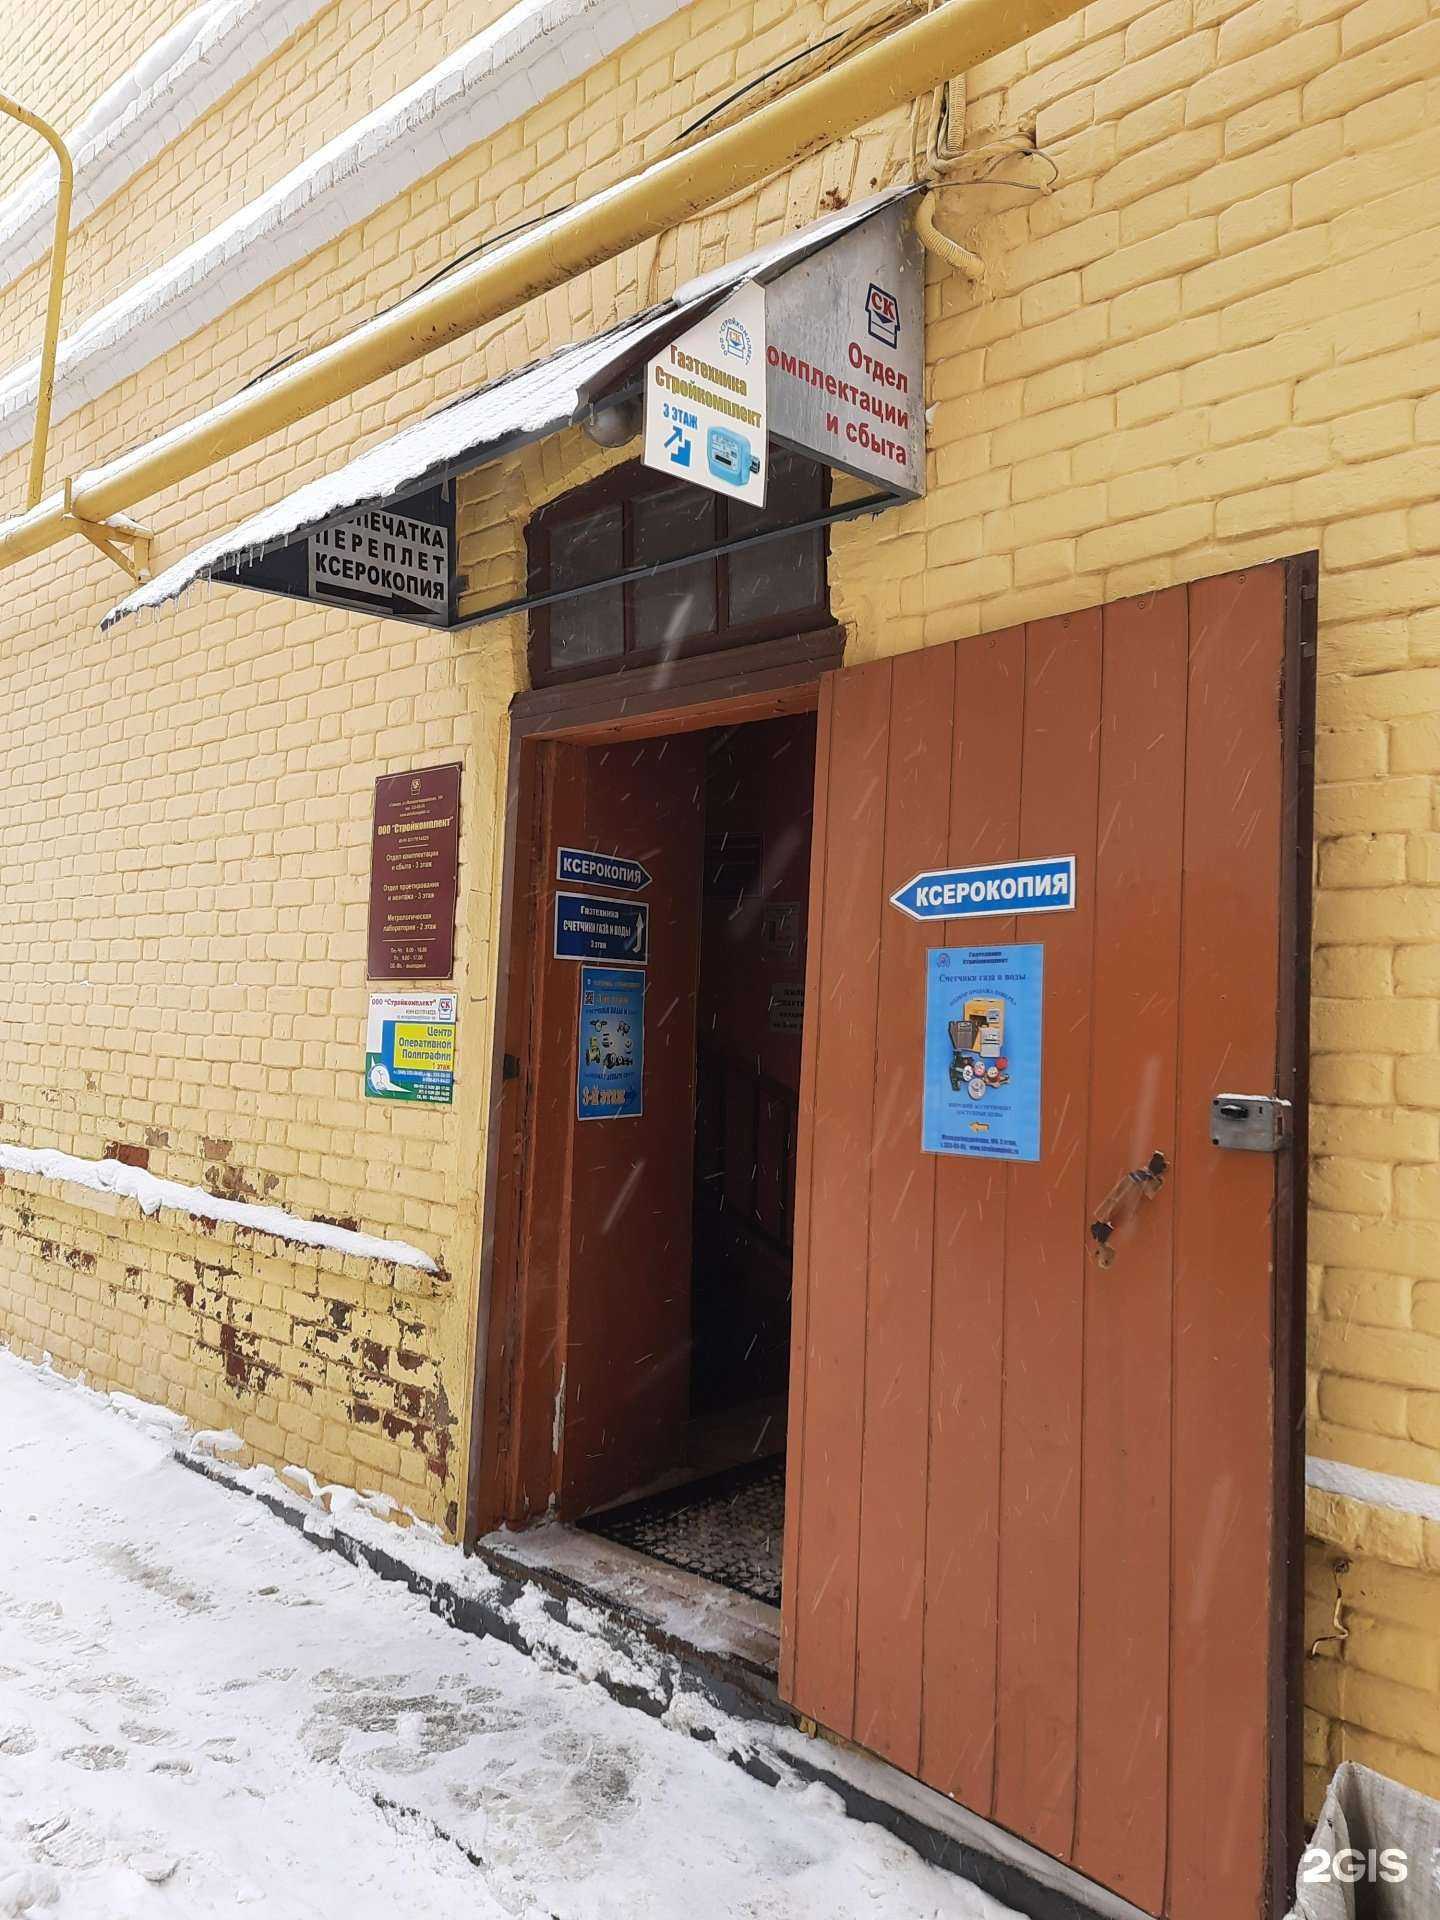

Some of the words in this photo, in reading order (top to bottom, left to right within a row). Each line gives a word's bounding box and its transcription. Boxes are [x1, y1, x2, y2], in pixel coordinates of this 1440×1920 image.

[871, 291, 895, 321] СК
[670, 344, 748, 397] Газтехника
[848, 342, 908, 394] Отдел
[655, 365, 763, 429] Стройкомплект
[766, 345, 909, 430] омплектации
[663, 402, 670, 418] 3
[672, 406, 698, 430] ЭТАЖ
[826, 412, 838, 435] и
[846, 422, 907, 465] сбыта
[315, 528, 445, 574] ПЕРЕПЛЕТ
[315, 551, 445, 601] КСЕРОКОПИЯ
[377, 824, 391, 836] ООО
[563, 857, 641, 884] КСЕРОКОПИЯ
[915, 872, 1068, 908] КСЕРОКОПИЯ
[580, 905, 619, 919] Газтехника
[563, 919, 596, 933] СЧЕТЧИКИ
[596, 922, 609, 935] ГАЗА
[614, 926, 631, 938] ВОДЫ
[371, 998, 383, 1006] ООО
[440, 1001, 451, 1009] СК
[398, 1036, 452, 1049] Оперативной
[427, 1026, 452, 1038] Центр
[402, 1048, 451, 1061] Полиграфии
